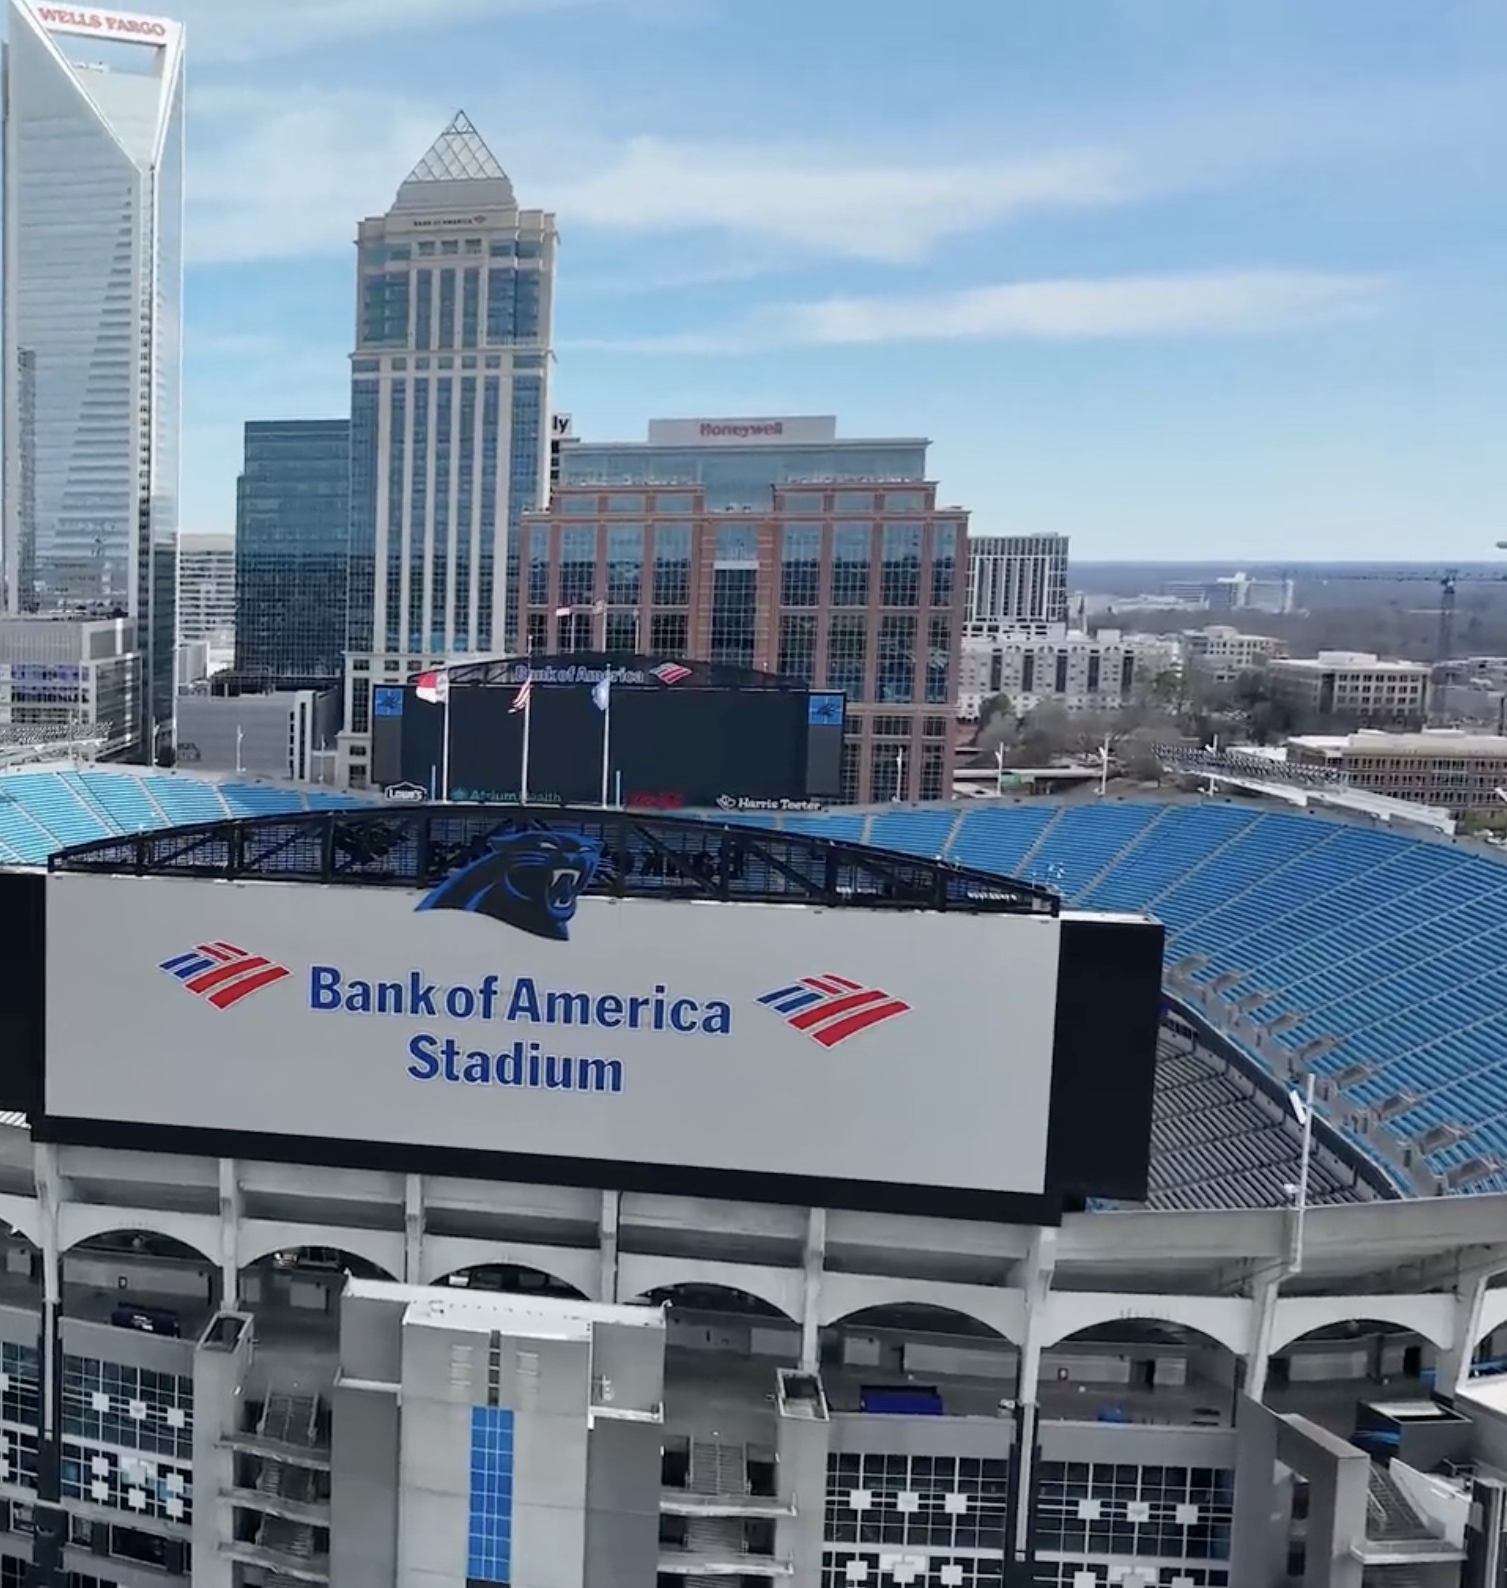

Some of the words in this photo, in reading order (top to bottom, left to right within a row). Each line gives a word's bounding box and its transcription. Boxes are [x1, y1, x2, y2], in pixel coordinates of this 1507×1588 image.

[37, 7, 102, 29] WELLS
[105, 16, 166, 37] FARGO
[553, 415, 570, 434] ly
[700, 422, 783, 438] Honeywell
[557, 665, 576, 682] of
[470, 789, 517, 801] Atrium
[738, 797, 778, 809] Harris
[779, 799, 821, 810] Teeter
[309, 964, 438, 1017] Bank
[445, 974, 500, 1020] of
[505, 976, 733, 1036] America
[406, 1033, 624, 1093] Stadium
